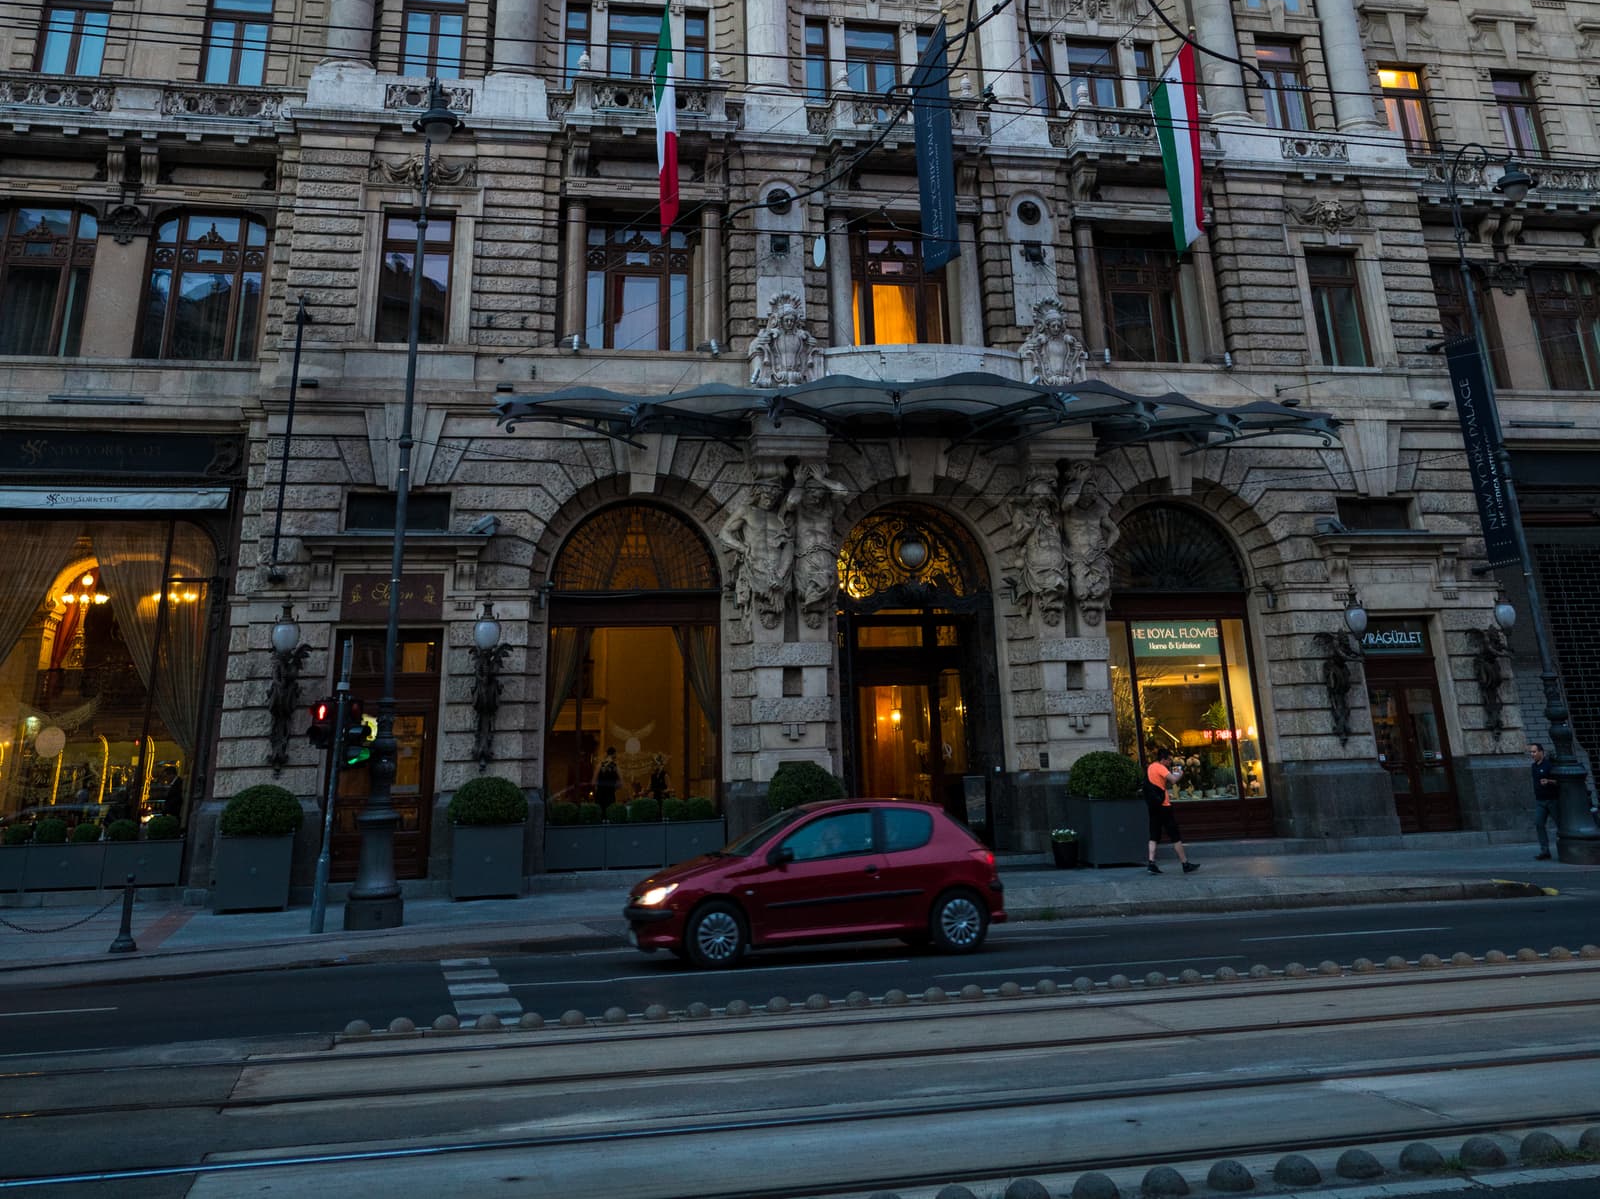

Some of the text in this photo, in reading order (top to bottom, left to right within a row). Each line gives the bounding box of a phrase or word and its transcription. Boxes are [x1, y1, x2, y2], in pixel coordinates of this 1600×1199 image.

[1459, 378, 1500, 530] NEW YORK PALACE
[371, 583, 415, 600] Saon
[1147, 628, 1178, 639] ROYAL
[1149, 642, 1167, 650] Home
